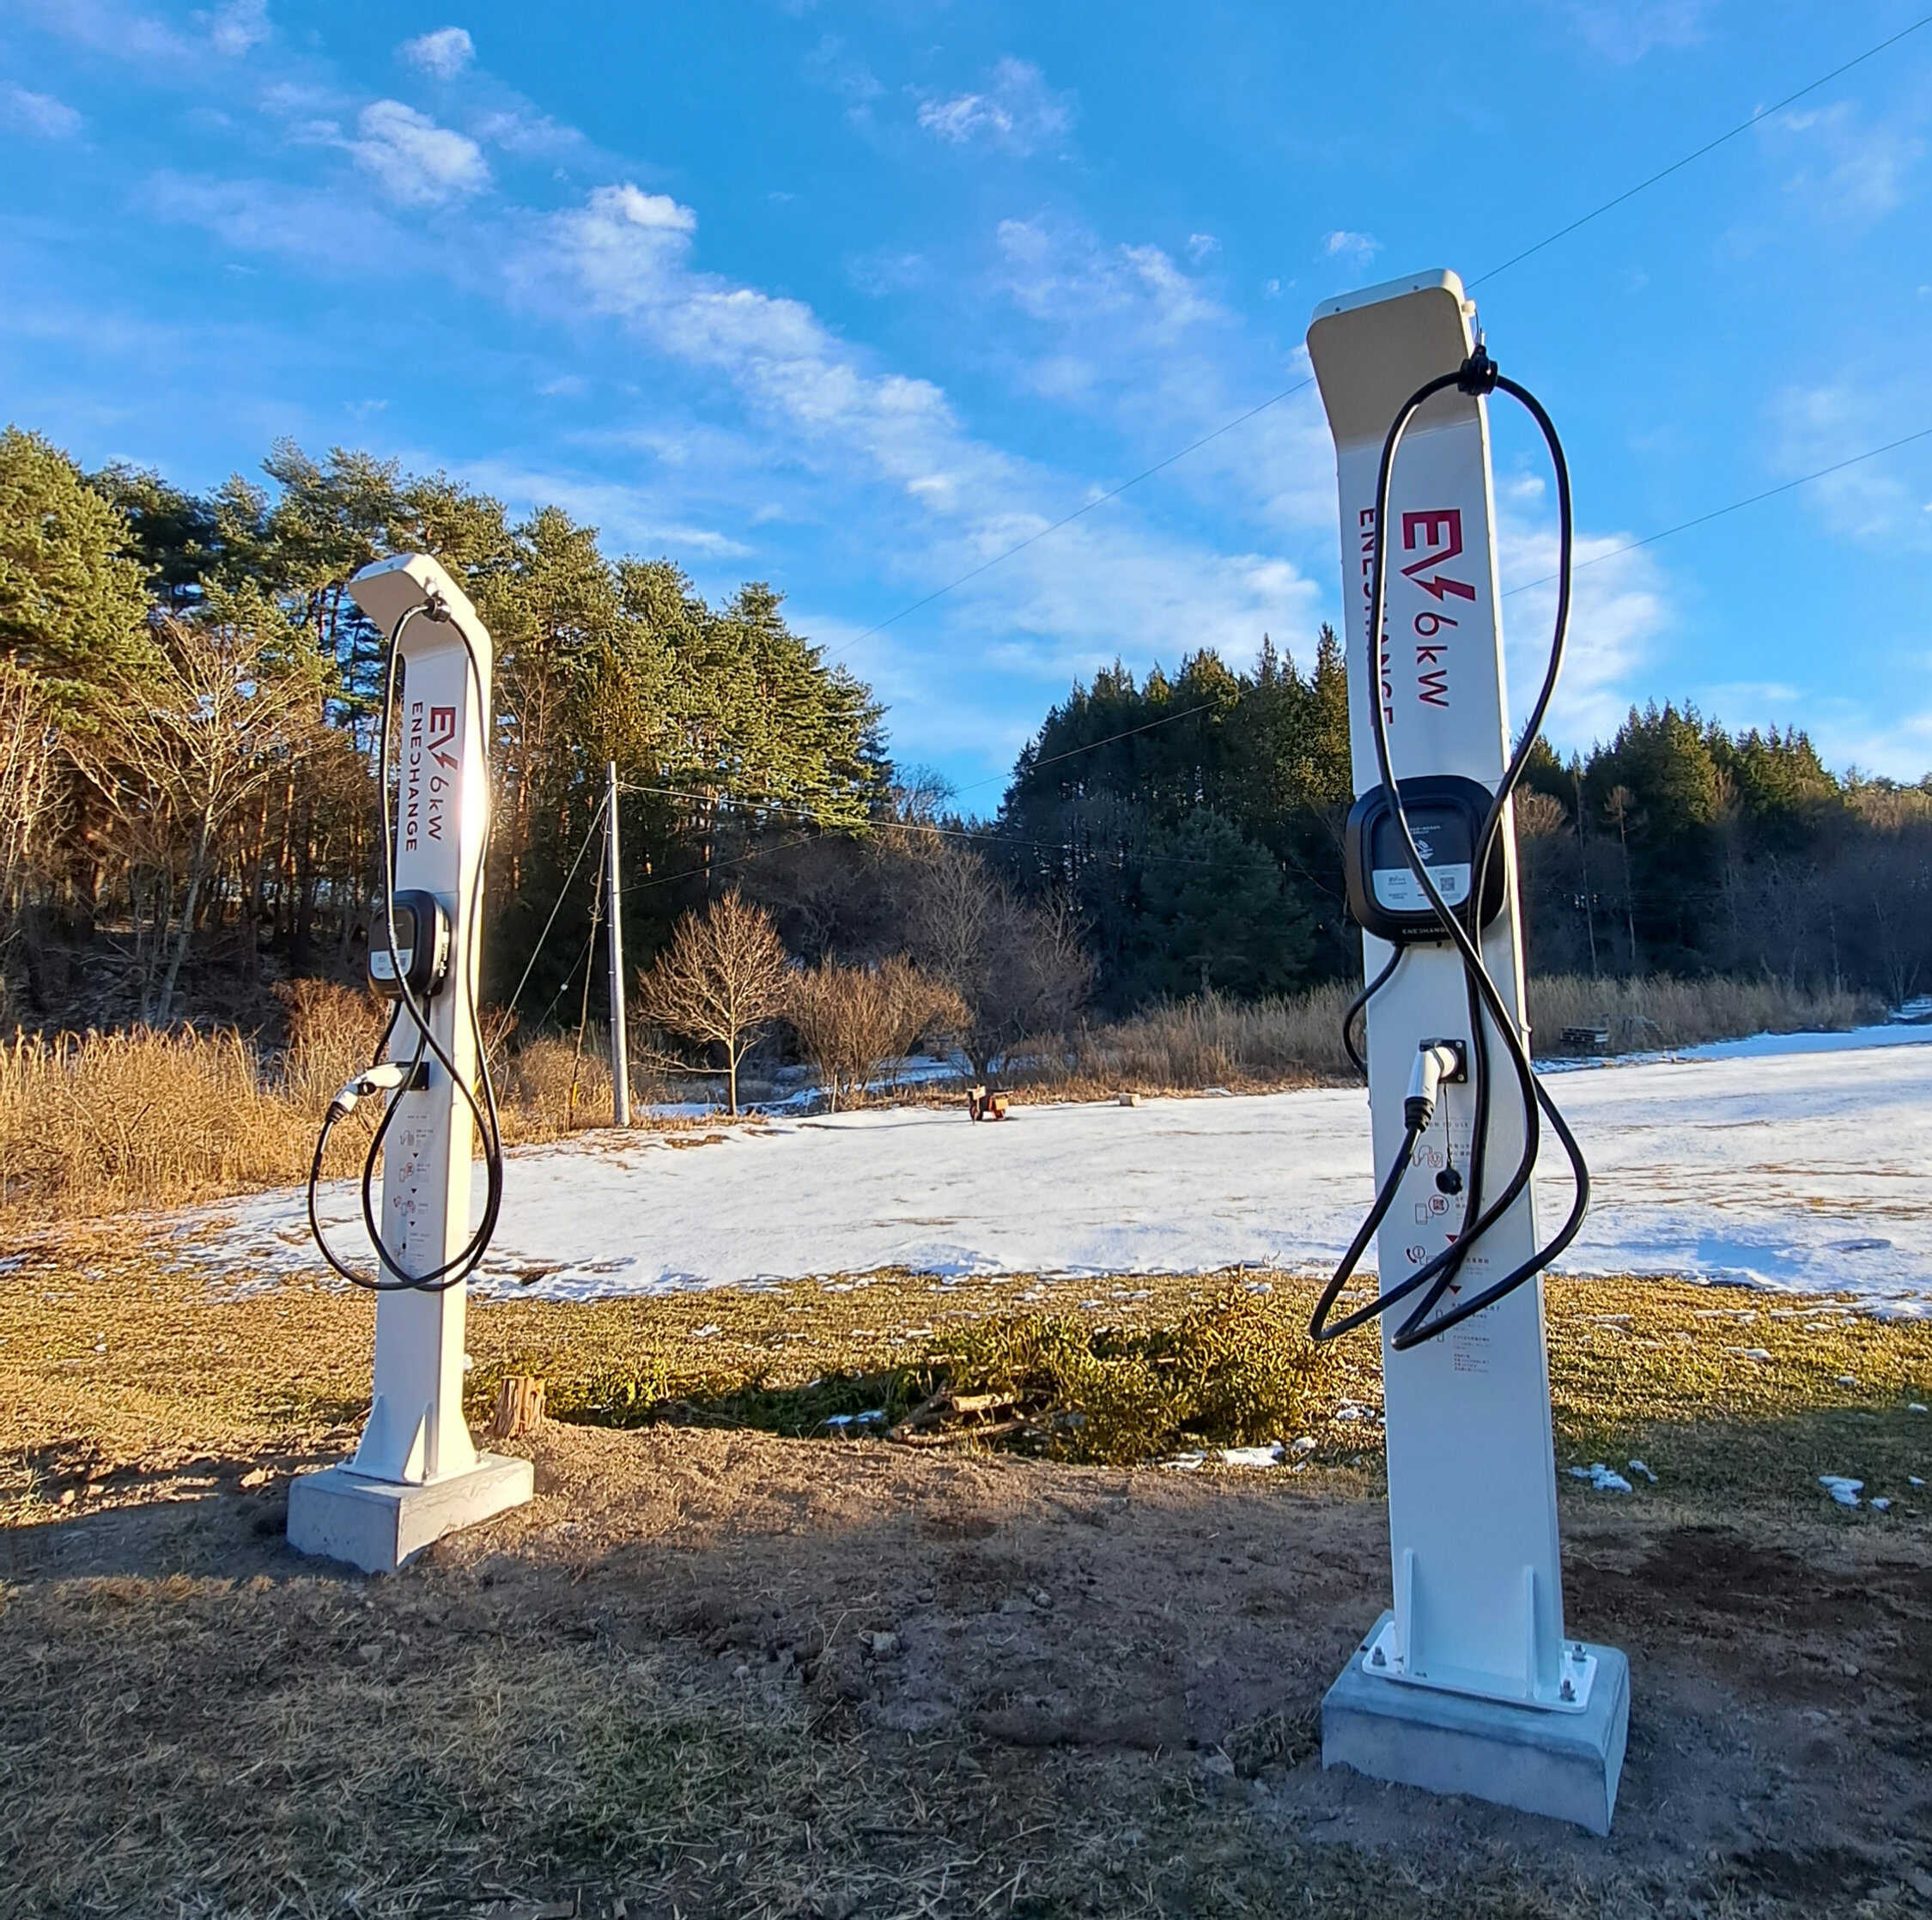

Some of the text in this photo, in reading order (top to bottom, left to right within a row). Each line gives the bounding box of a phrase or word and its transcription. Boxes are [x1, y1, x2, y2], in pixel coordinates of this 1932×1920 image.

[1414, 611, 1459, 708] 6kW
[405, 702, 423, 852] ENECHANGE
[428, 775, 449, 841] 6kW
